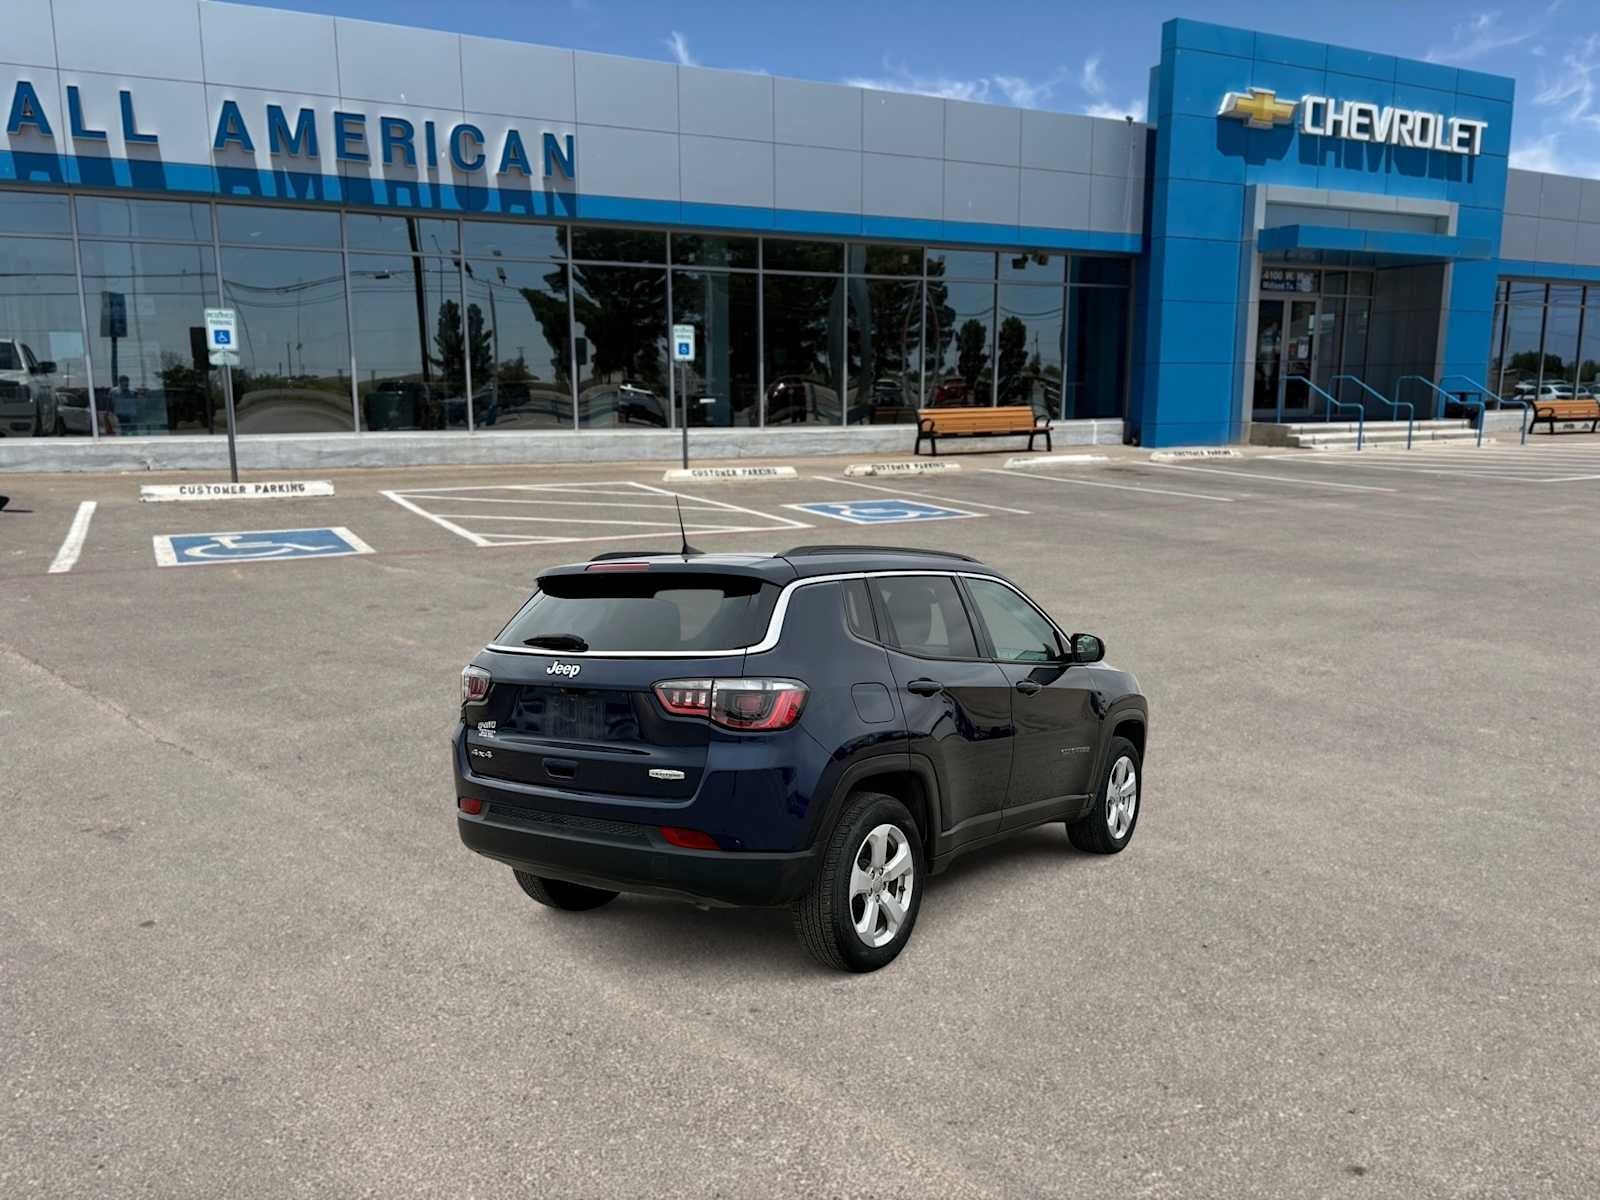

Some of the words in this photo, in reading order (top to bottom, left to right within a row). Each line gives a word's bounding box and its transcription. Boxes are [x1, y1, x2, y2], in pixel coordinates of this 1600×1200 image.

[6, 80, 159, 144] ALL
[213, 99, 576, 179] AMERICAN
[1301, 93, 1488, 156] CHEVROLET
[691, 469, 737, 477] CUSTOMER
[741, 468, 777, 476] PARKING
[179, 484, 247, 495] CUSTOMER
[254, 482, 306, 494] PARKING
[546, 660, 581, 678] Jeep
